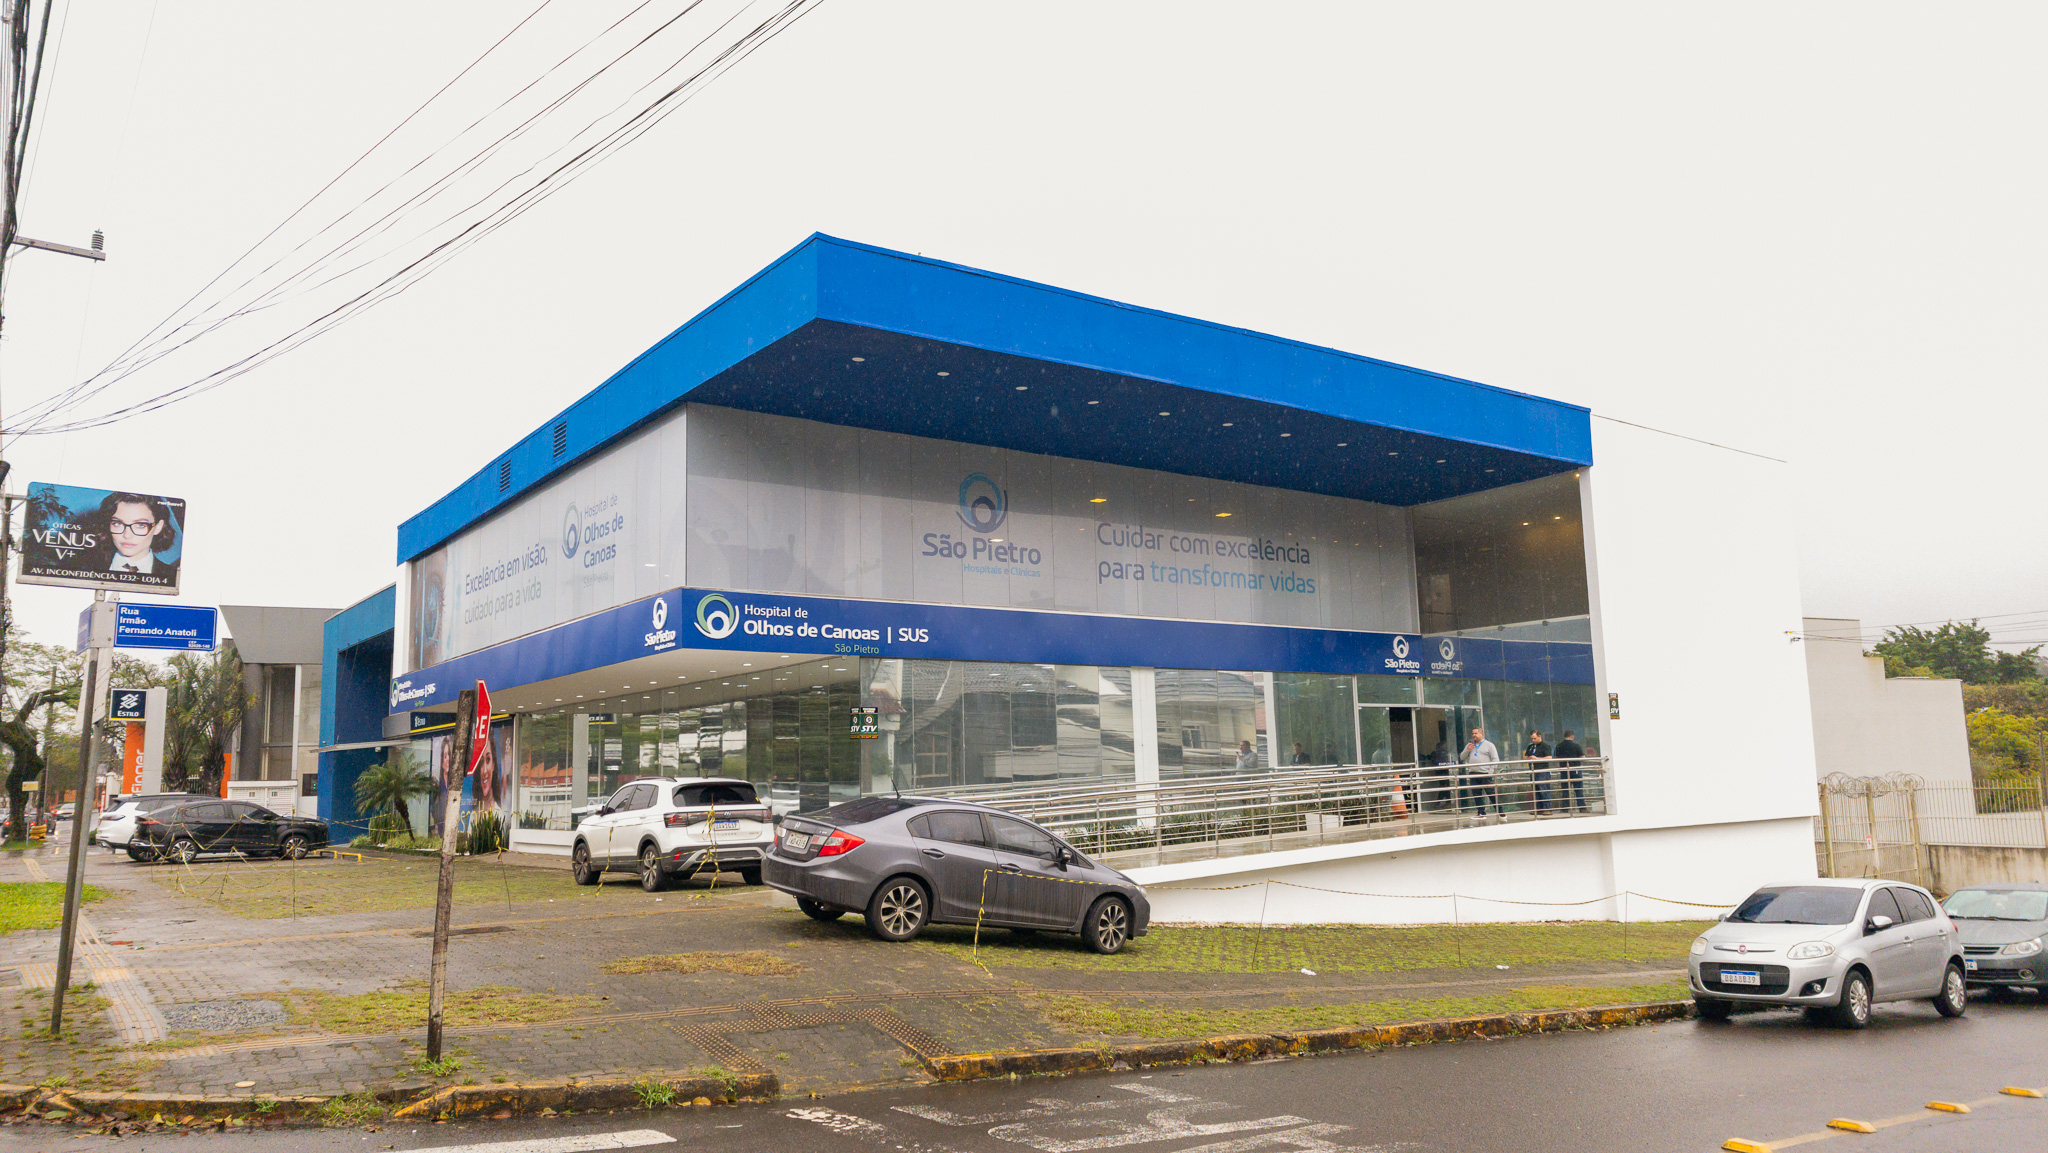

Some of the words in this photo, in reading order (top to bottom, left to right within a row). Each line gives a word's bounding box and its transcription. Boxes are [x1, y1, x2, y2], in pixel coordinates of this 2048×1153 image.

[52, 522, 82, 531] ÓTICAS
[584, 521, 610, 545] Olhos
[611, 511, 624, 533] de
[32, 528, 96, 548] VÊNUS
[1097, 522, 1164, 550] Cuidar
[1169, 535, 1210, 556] com
[1215, 538, 1310, 565] excelência
[55, 548, 76, 561] V+
[583, 543, 617, 569] Canoas
[922, 532, 967, 559] São
[972, 537, 1041, 565] Pietro
[30, 567, 45, 575] AV.
[46, 568, 117, 581] INCONFIDÊNCIA,
[141, 576, 161, 584] LOJA
[465, 559, 505, 596] Excelência
[506, 557, 520, 578] em
[521, 542, 548, 571] visão,
[963, 563, 1002, 575] Hospitais
[1099, 561, 1145, 584] para
[1150, 561, 1265, 590] transformar
[1269, 570, 1316, 594] vidas
[495, 592, 514, 620] para
[522, 575, 542, 603] vida
[120, 607, 140, 615] Rua
[744, 604, 791, 618] Hospital
[794, 608, 808, 618] de
[119, 616, 147, 625] Irmão
[118, 625, 163, 635] Fernando
[164, 627, 197, 637] Anatoli
[743, 620, 794, 637] Olhos
[796, 623, 818, 638] de
[820, 624, 880, 641] Canoas
[898, 628, 929, 643] SUS
[834, 643, 851, 653] São
[853, 645, 880, 654] Pietro
[1384, 658, 1398, 668] São
[1398, 659, 1420, 669] Pietro
